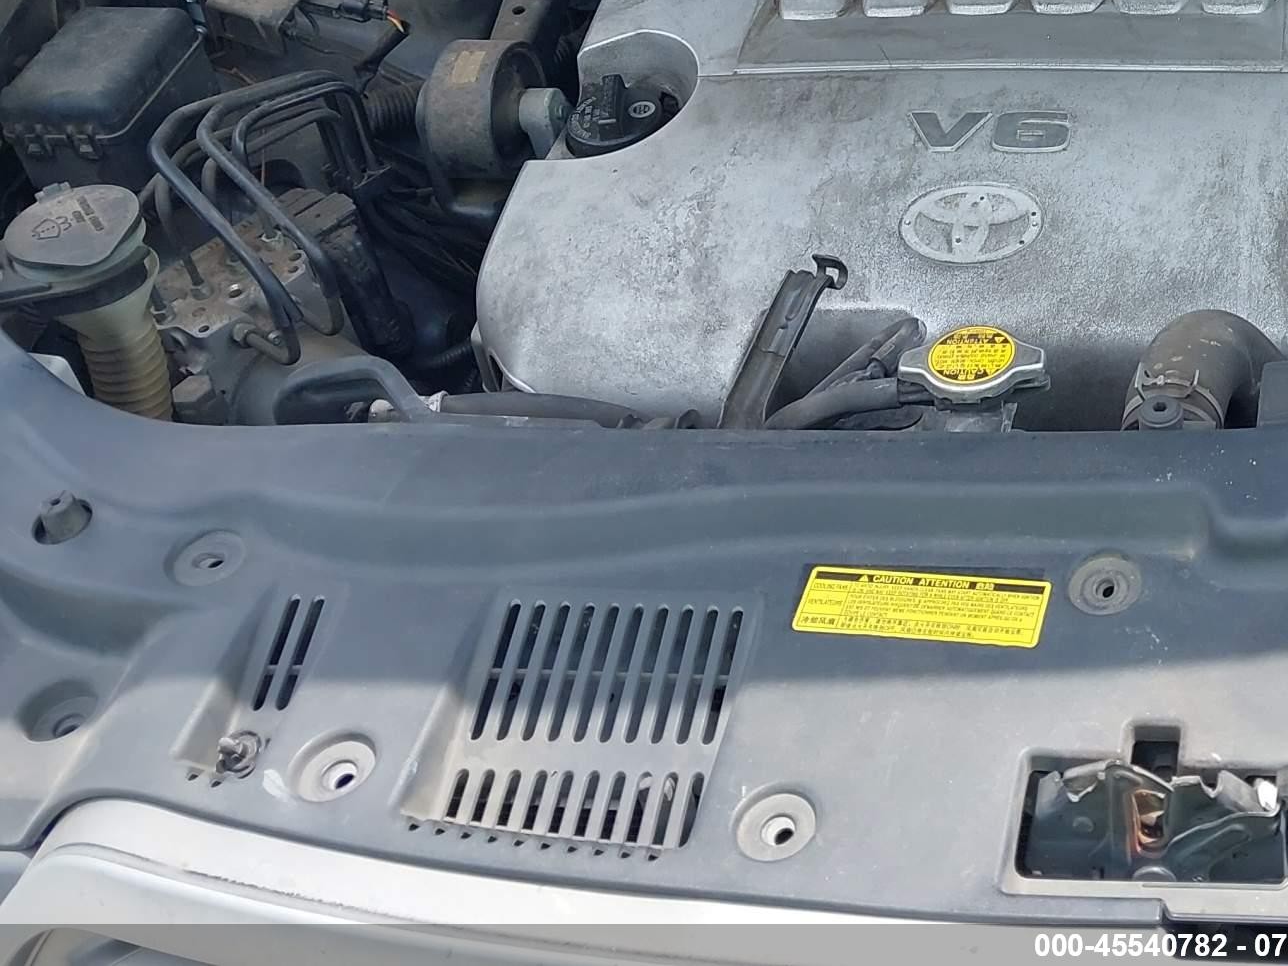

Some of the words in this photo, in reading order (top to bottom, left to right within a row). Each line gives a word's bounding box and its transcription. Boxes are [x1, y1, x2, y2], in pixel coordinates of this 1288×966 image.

[908, 110, 1072, 153] V6
[873, 575, 913, 585] CAUTION
[919, 578, 970, 589] ATTENTION
